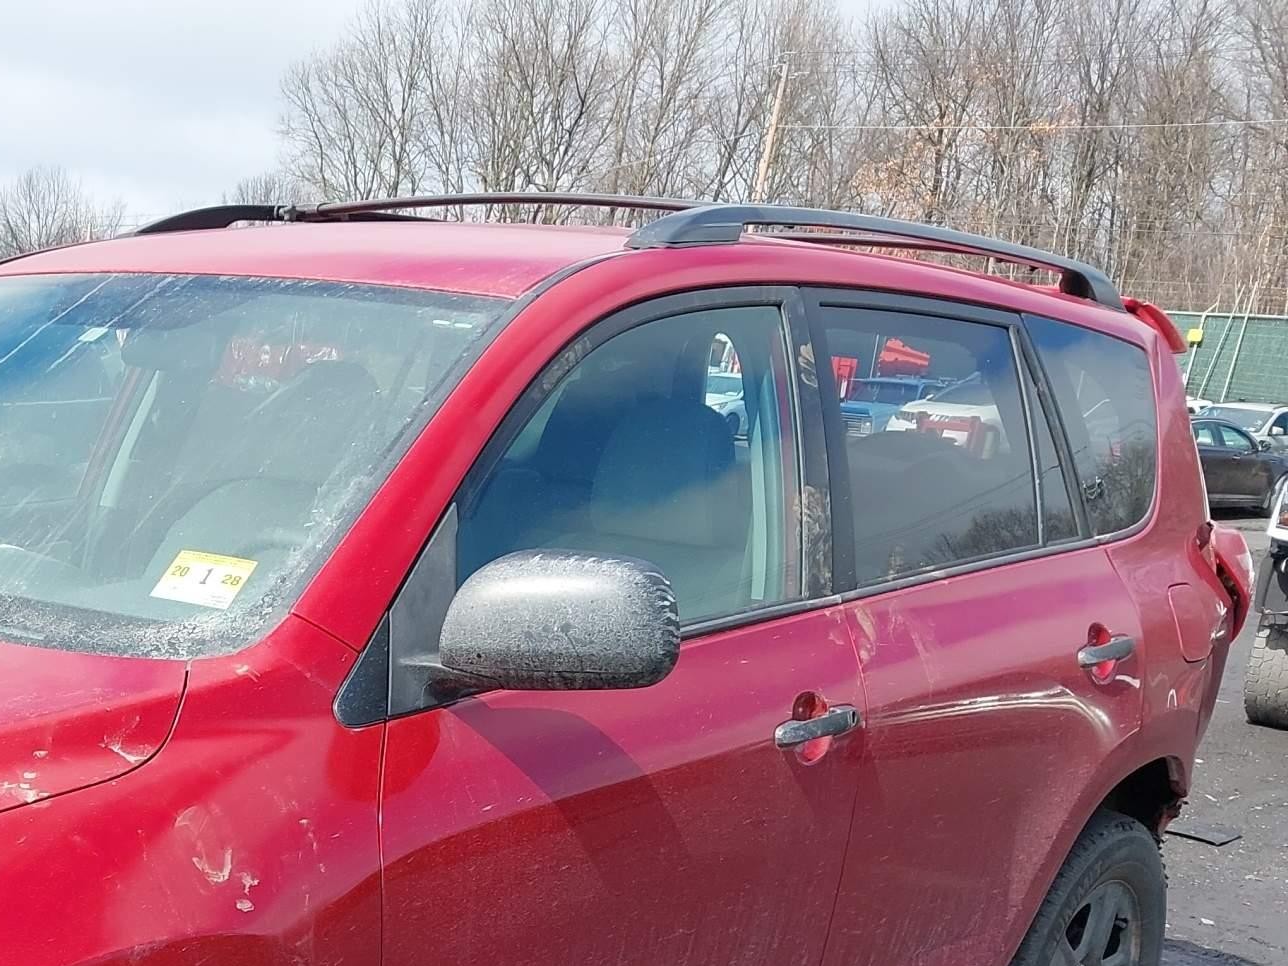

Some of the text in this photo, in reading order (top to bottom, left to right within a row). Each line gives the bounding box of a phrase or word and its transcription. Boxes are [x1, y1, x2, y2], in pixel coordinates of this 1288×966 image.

[171, 565, 242, 586] 20 1 28
